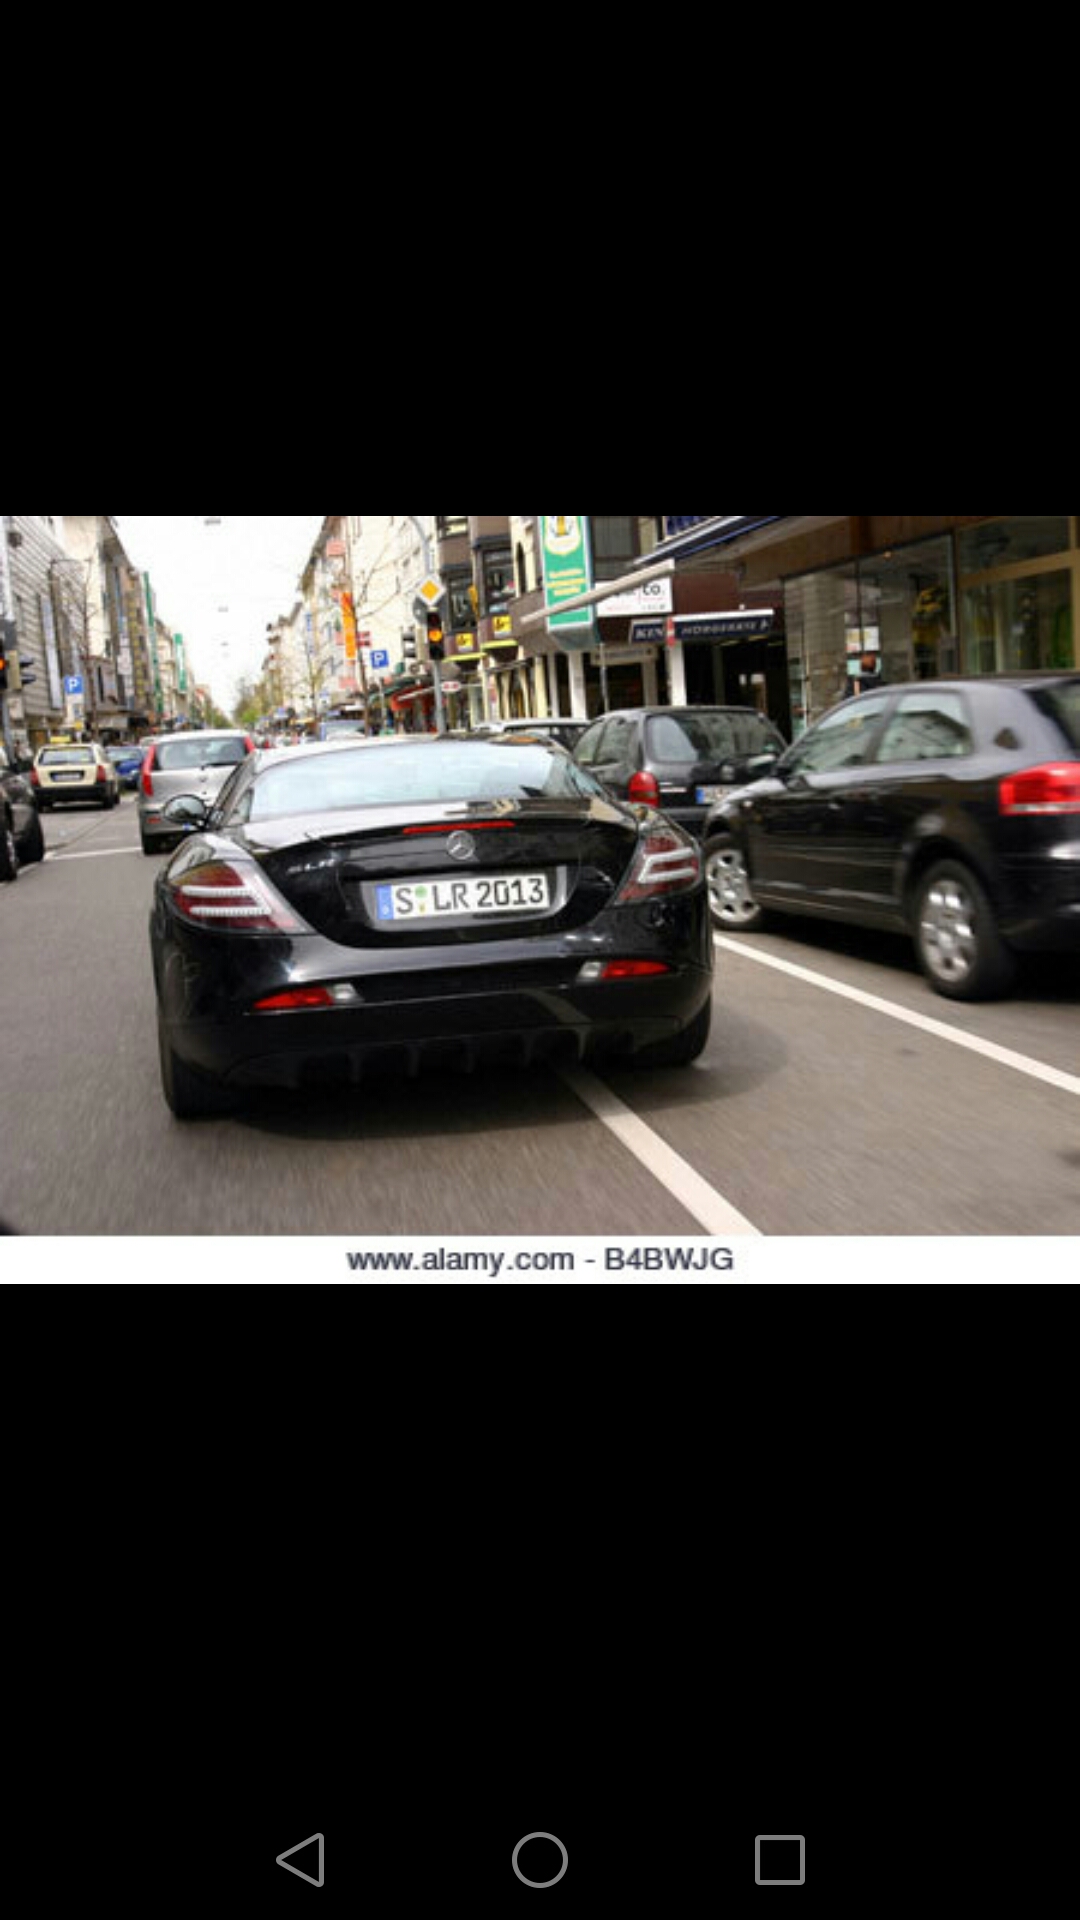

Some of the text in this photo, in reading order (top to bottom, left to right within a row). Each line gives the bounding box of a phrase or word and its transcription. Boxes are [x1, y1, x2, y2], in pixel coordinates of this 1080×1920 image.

[395, 877, 544, 914] S LR 2013
